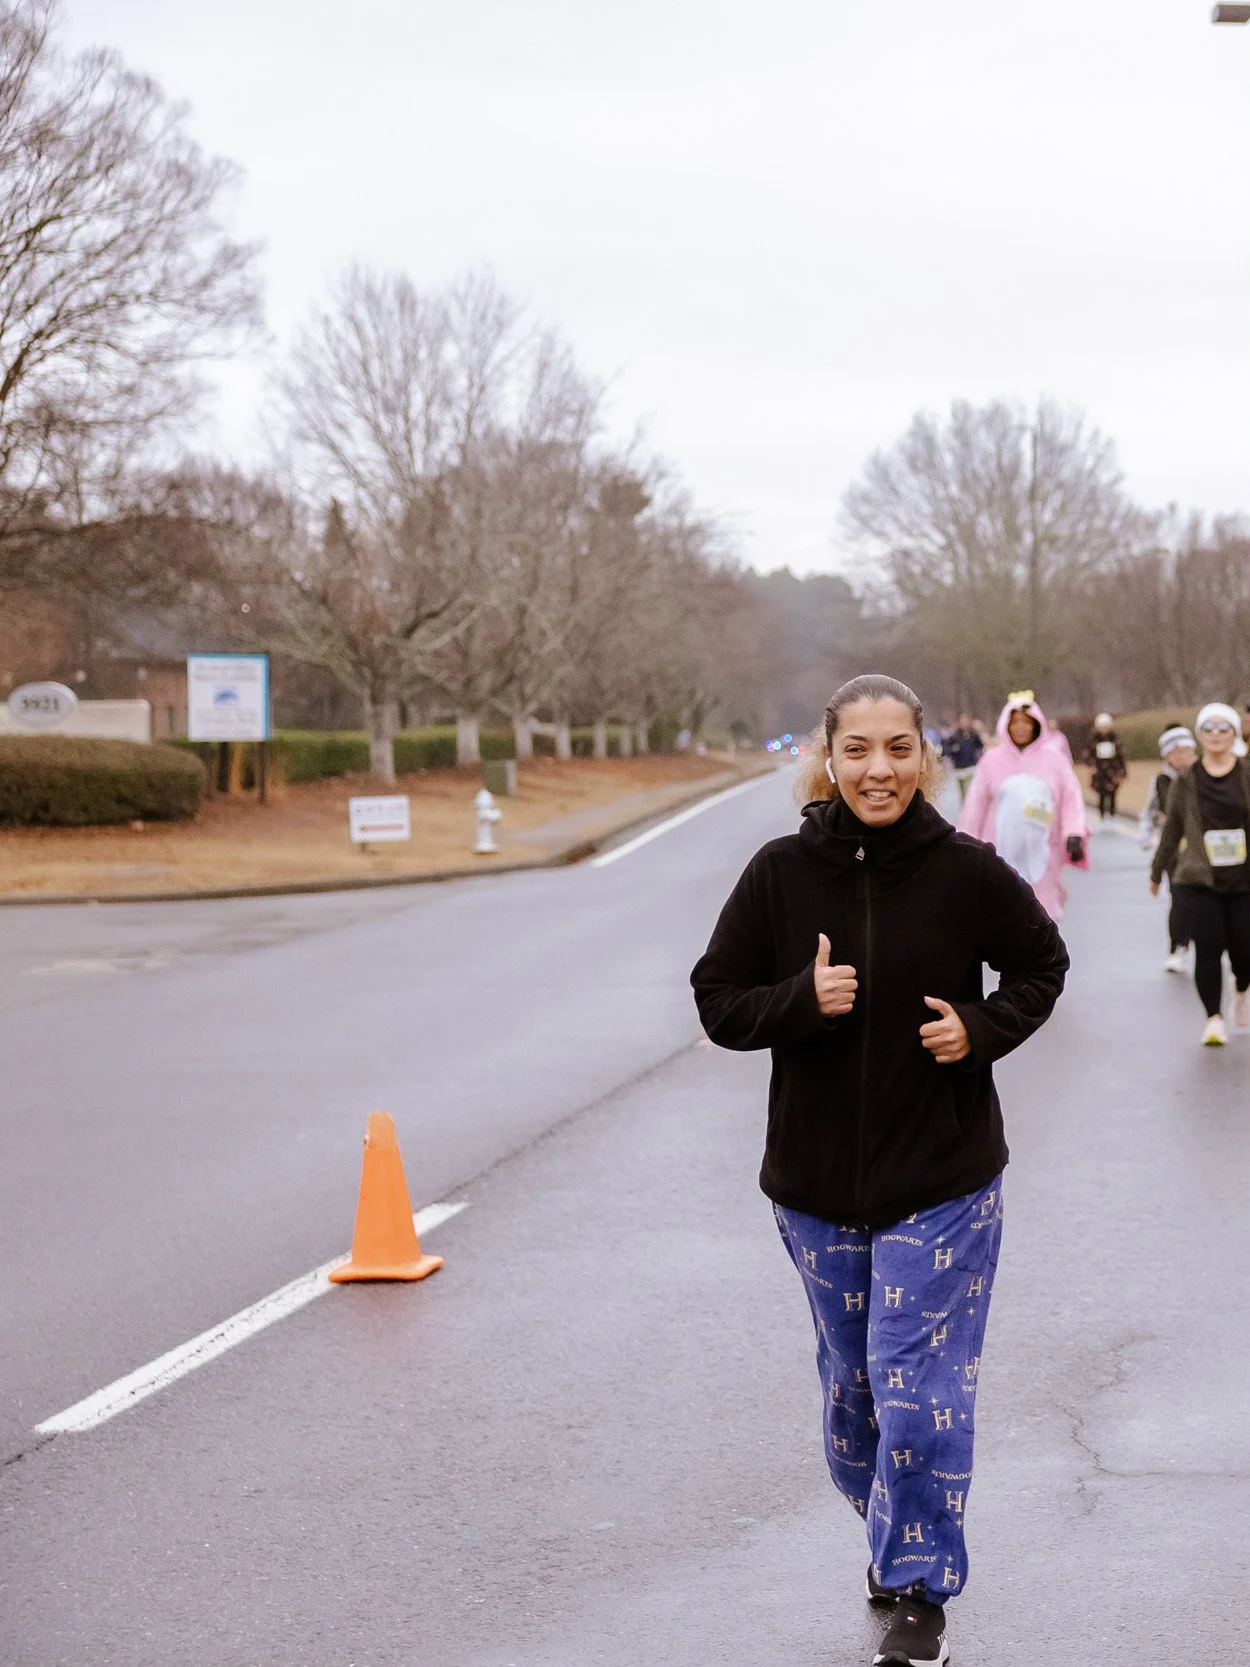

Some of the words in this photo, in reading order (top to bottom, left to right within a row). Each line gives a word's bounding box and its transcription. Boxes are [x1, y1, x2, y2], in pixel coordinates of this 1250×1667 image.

[826, 1243, 872, 1254] HOGWART
[881, 1234, 925, 1247] HOGWARTS
[802, 1246, 817, 1271] H
[933, 1247, 954, 1270] H
[884, 1286, 905, 1309] H
[967, 1276, 984, 1298] H
[843, 1291, 866, 1312] H
[921, 1310, 949, 1320] WARTS
[930, 1324, 948, 1347] H
[888, 1368, 905, 1389] H
[932, 1408, 954, 1431] H
[831, 1434, 849, 1453] H
[891, 1449, 914, 1470] H
[931, 1469, 973, 1480] OGWARTS
[946, 1490, 963, 1513] H
[902, 1522, 924, 1544] H
[941, 1566, 960, 1590] H
